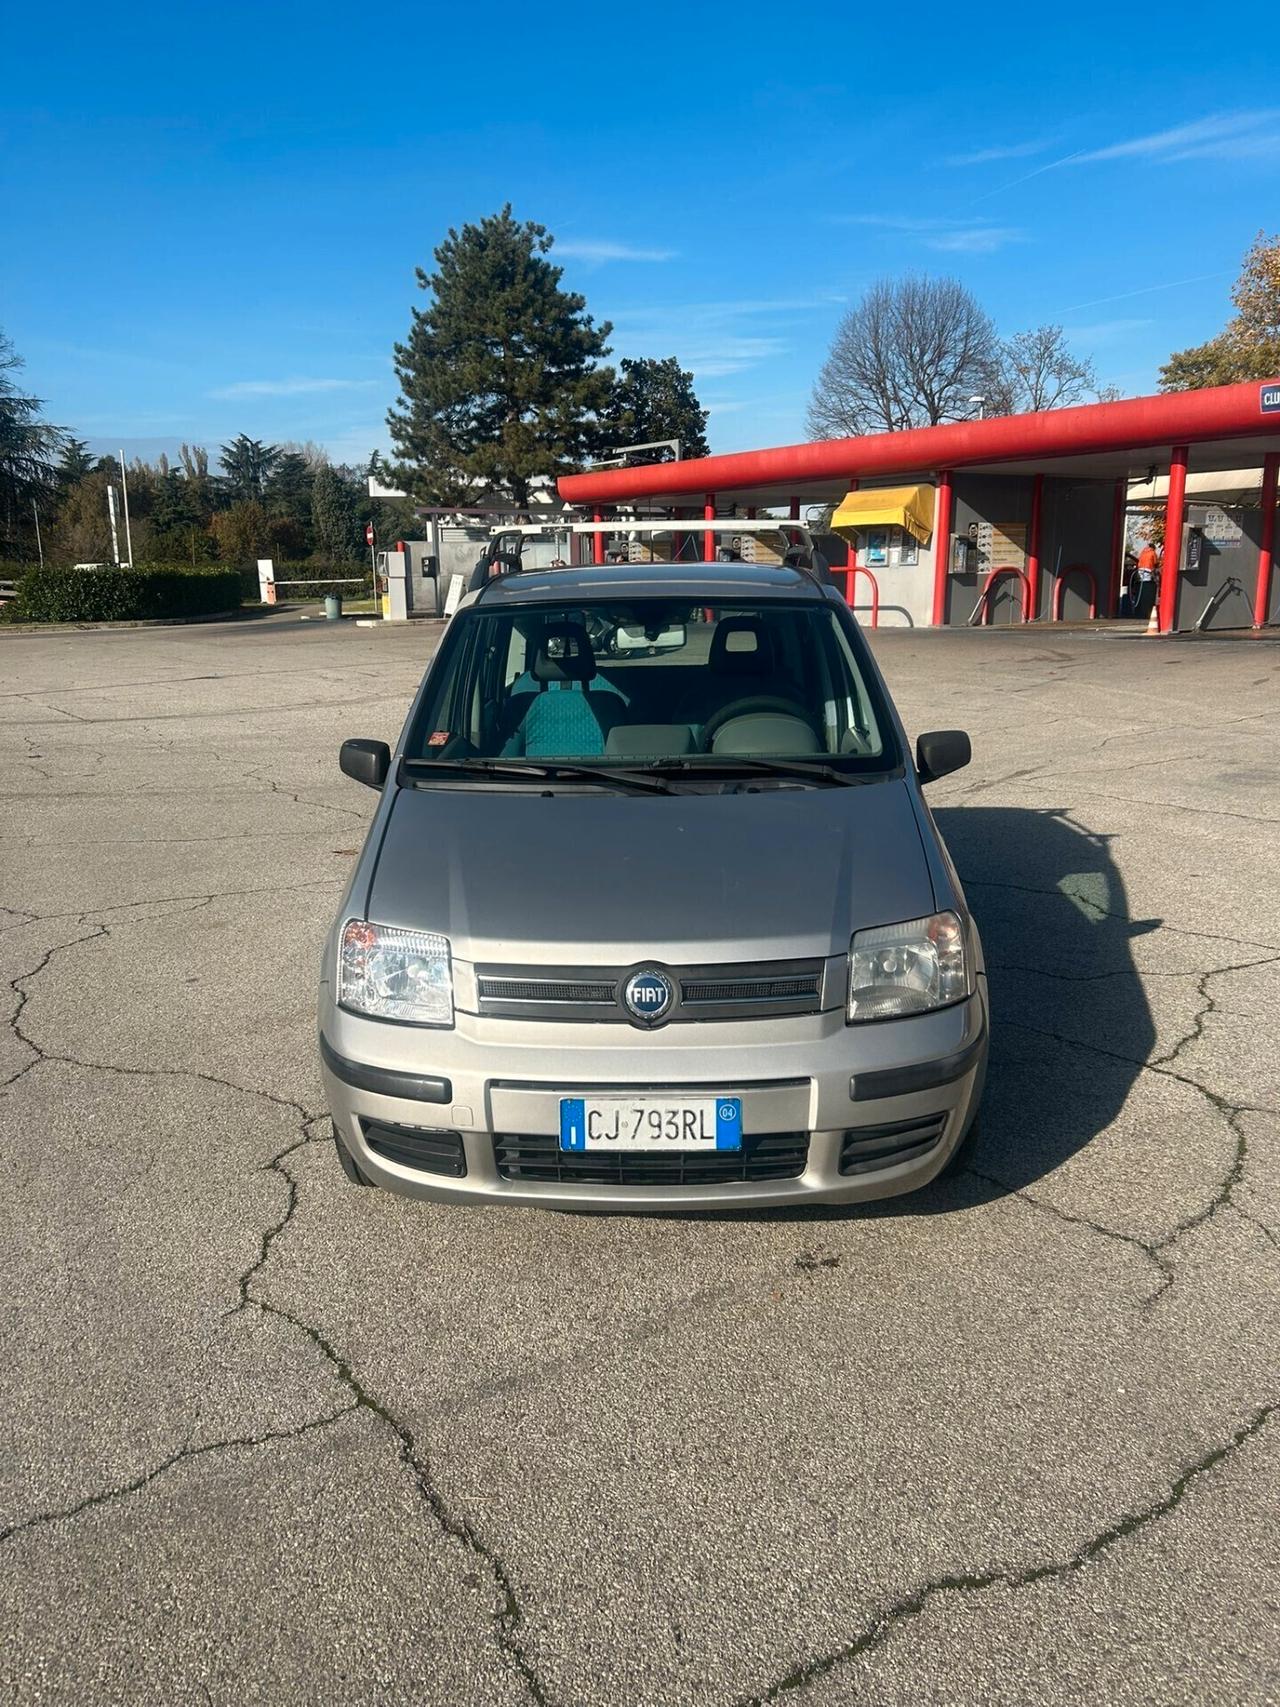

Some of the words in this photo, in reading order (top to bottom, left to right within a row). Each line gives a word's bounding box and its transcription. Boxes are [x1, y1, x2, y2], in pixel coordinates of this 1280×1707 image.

[1264, 392, 1280, 405] CLU
[633, 987, 664, 1003] FIAT
[722, 1108, 733, 1117] 04
